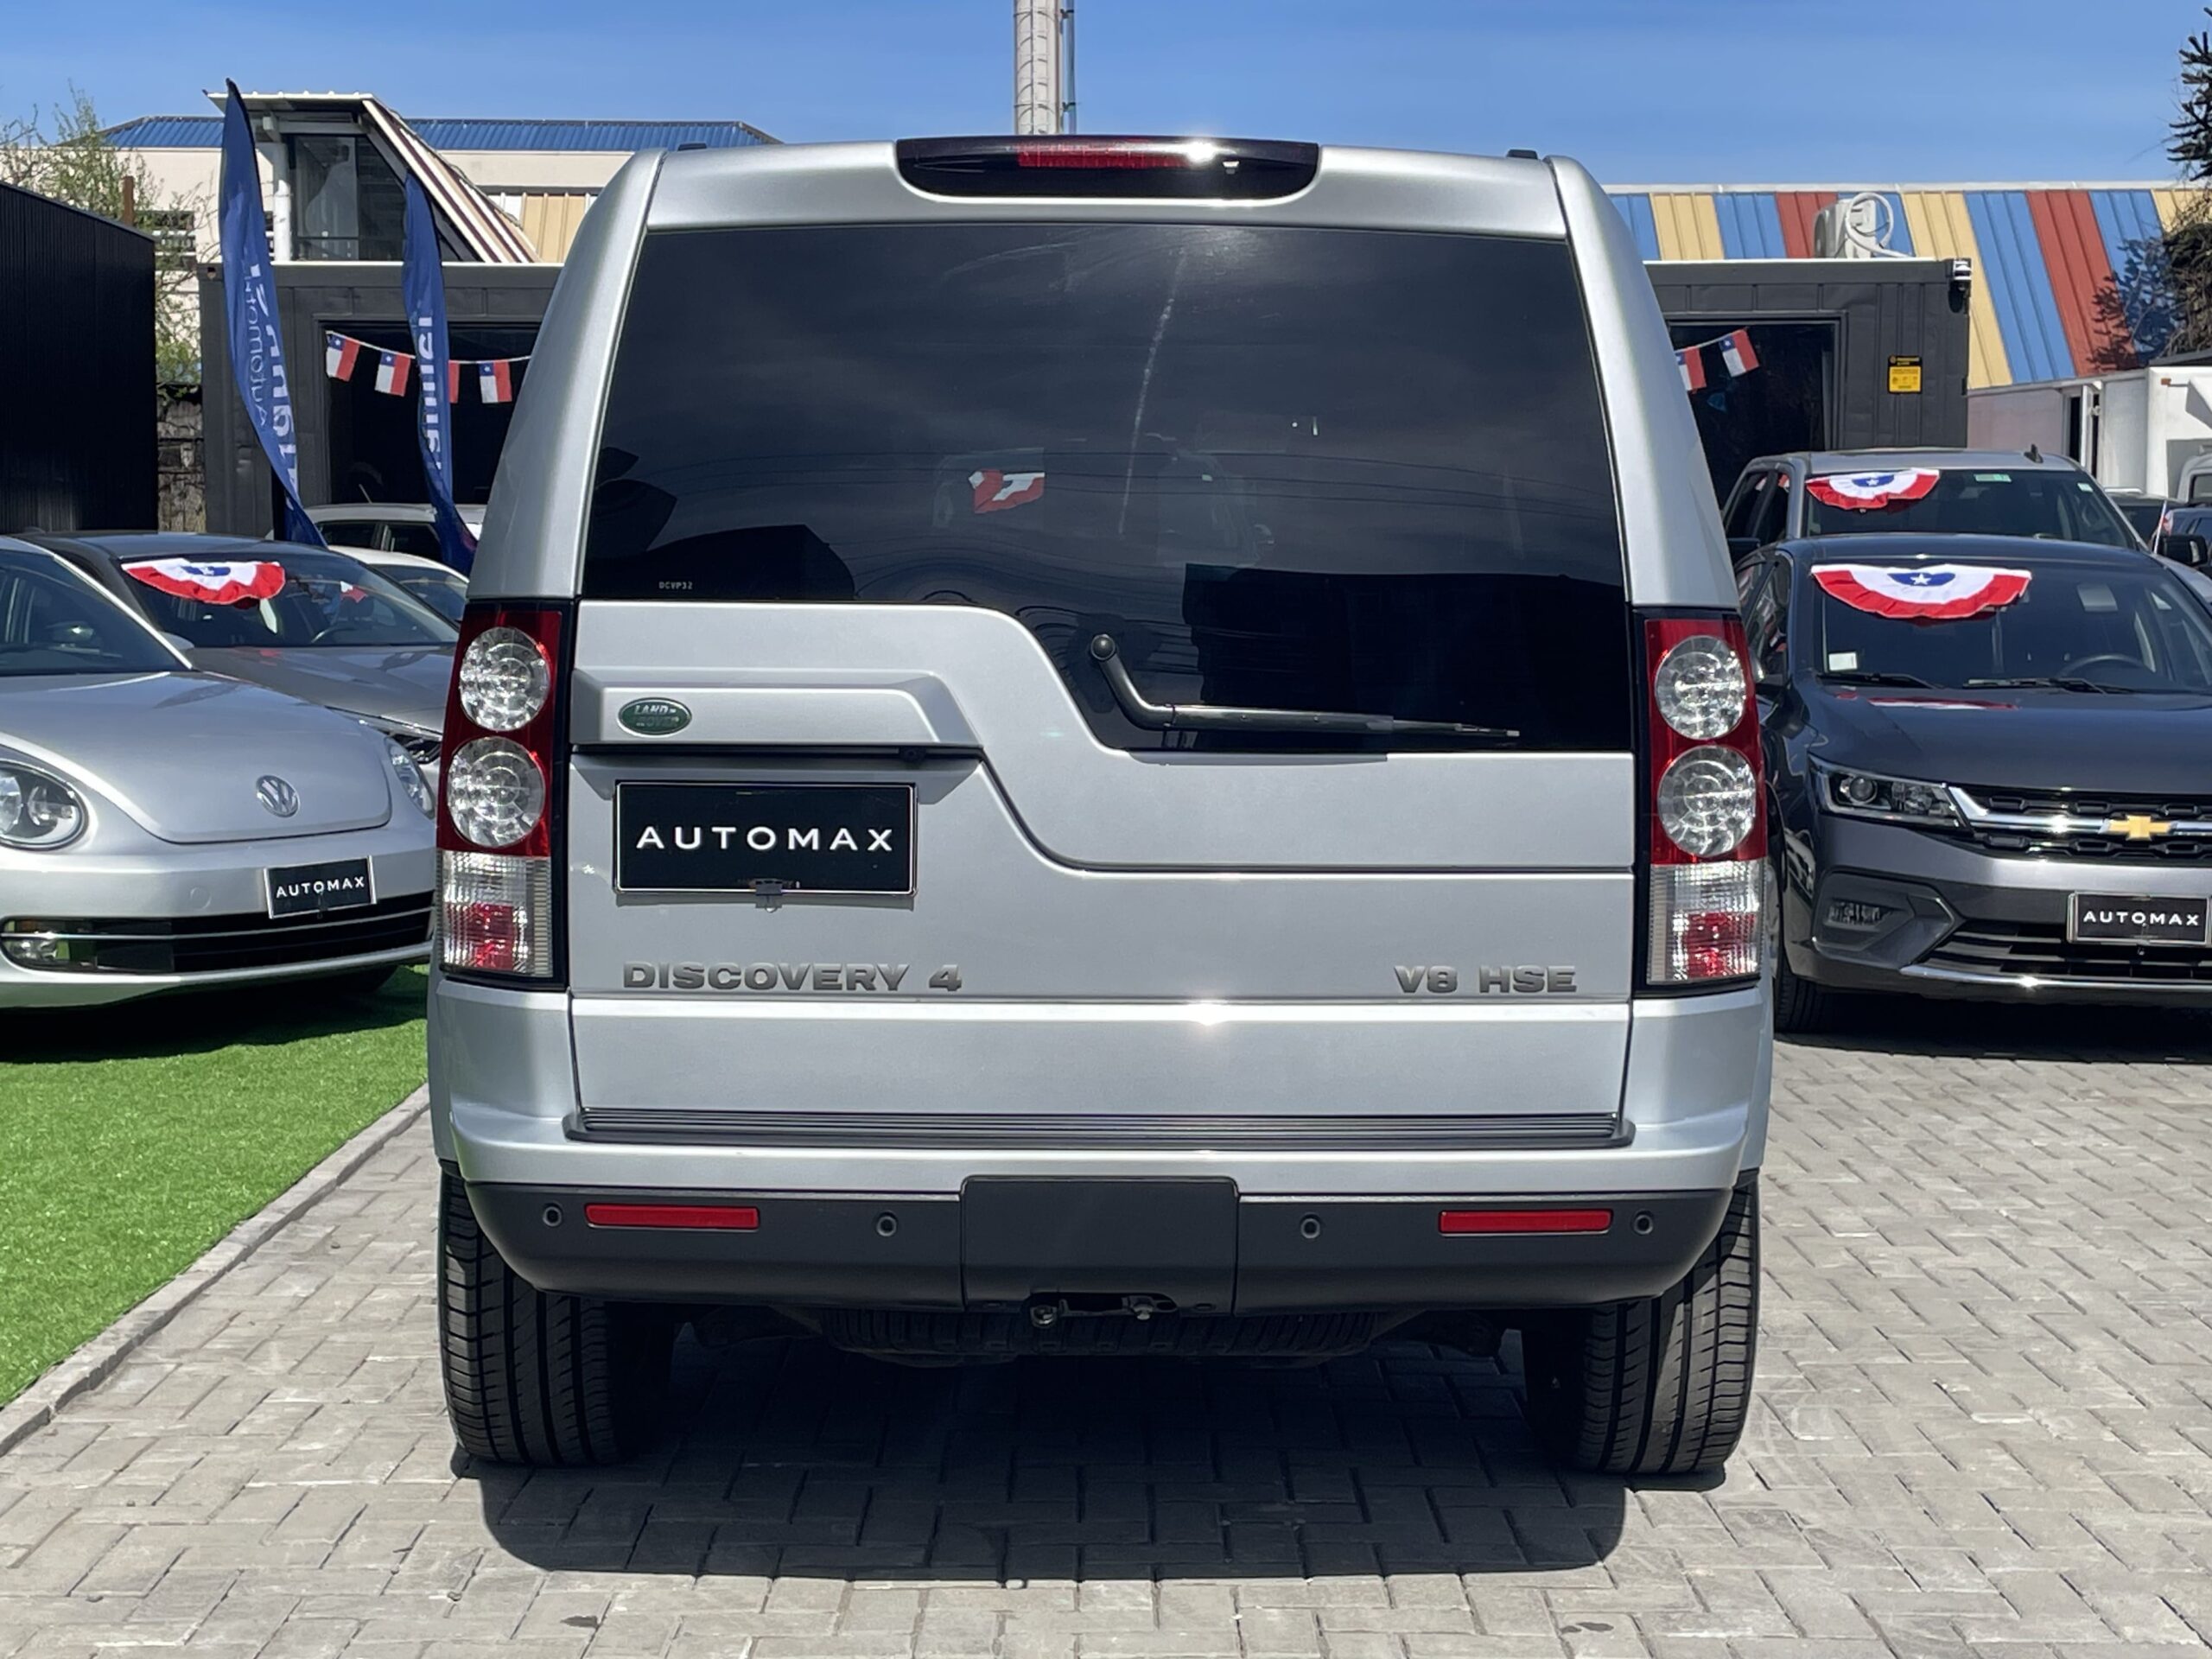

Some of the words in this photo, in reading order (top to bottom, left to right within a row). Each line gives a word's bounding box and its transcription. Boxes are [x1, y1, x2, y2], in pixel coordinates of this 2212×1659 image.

[633, 704, 670, 715] LAND
[636, 826, 893, 851] AUTOMAX
[276, 876, 365, 899] AUTOMAX
[2082, 911, 2200, 926] AUTOMAX
[623, 961, 910, 991] DISCOVERY
[928, 963, 963, 992] 4
[1394, 965, 1458, 994] V8
[1478, 964, 1578, 994] HSE
